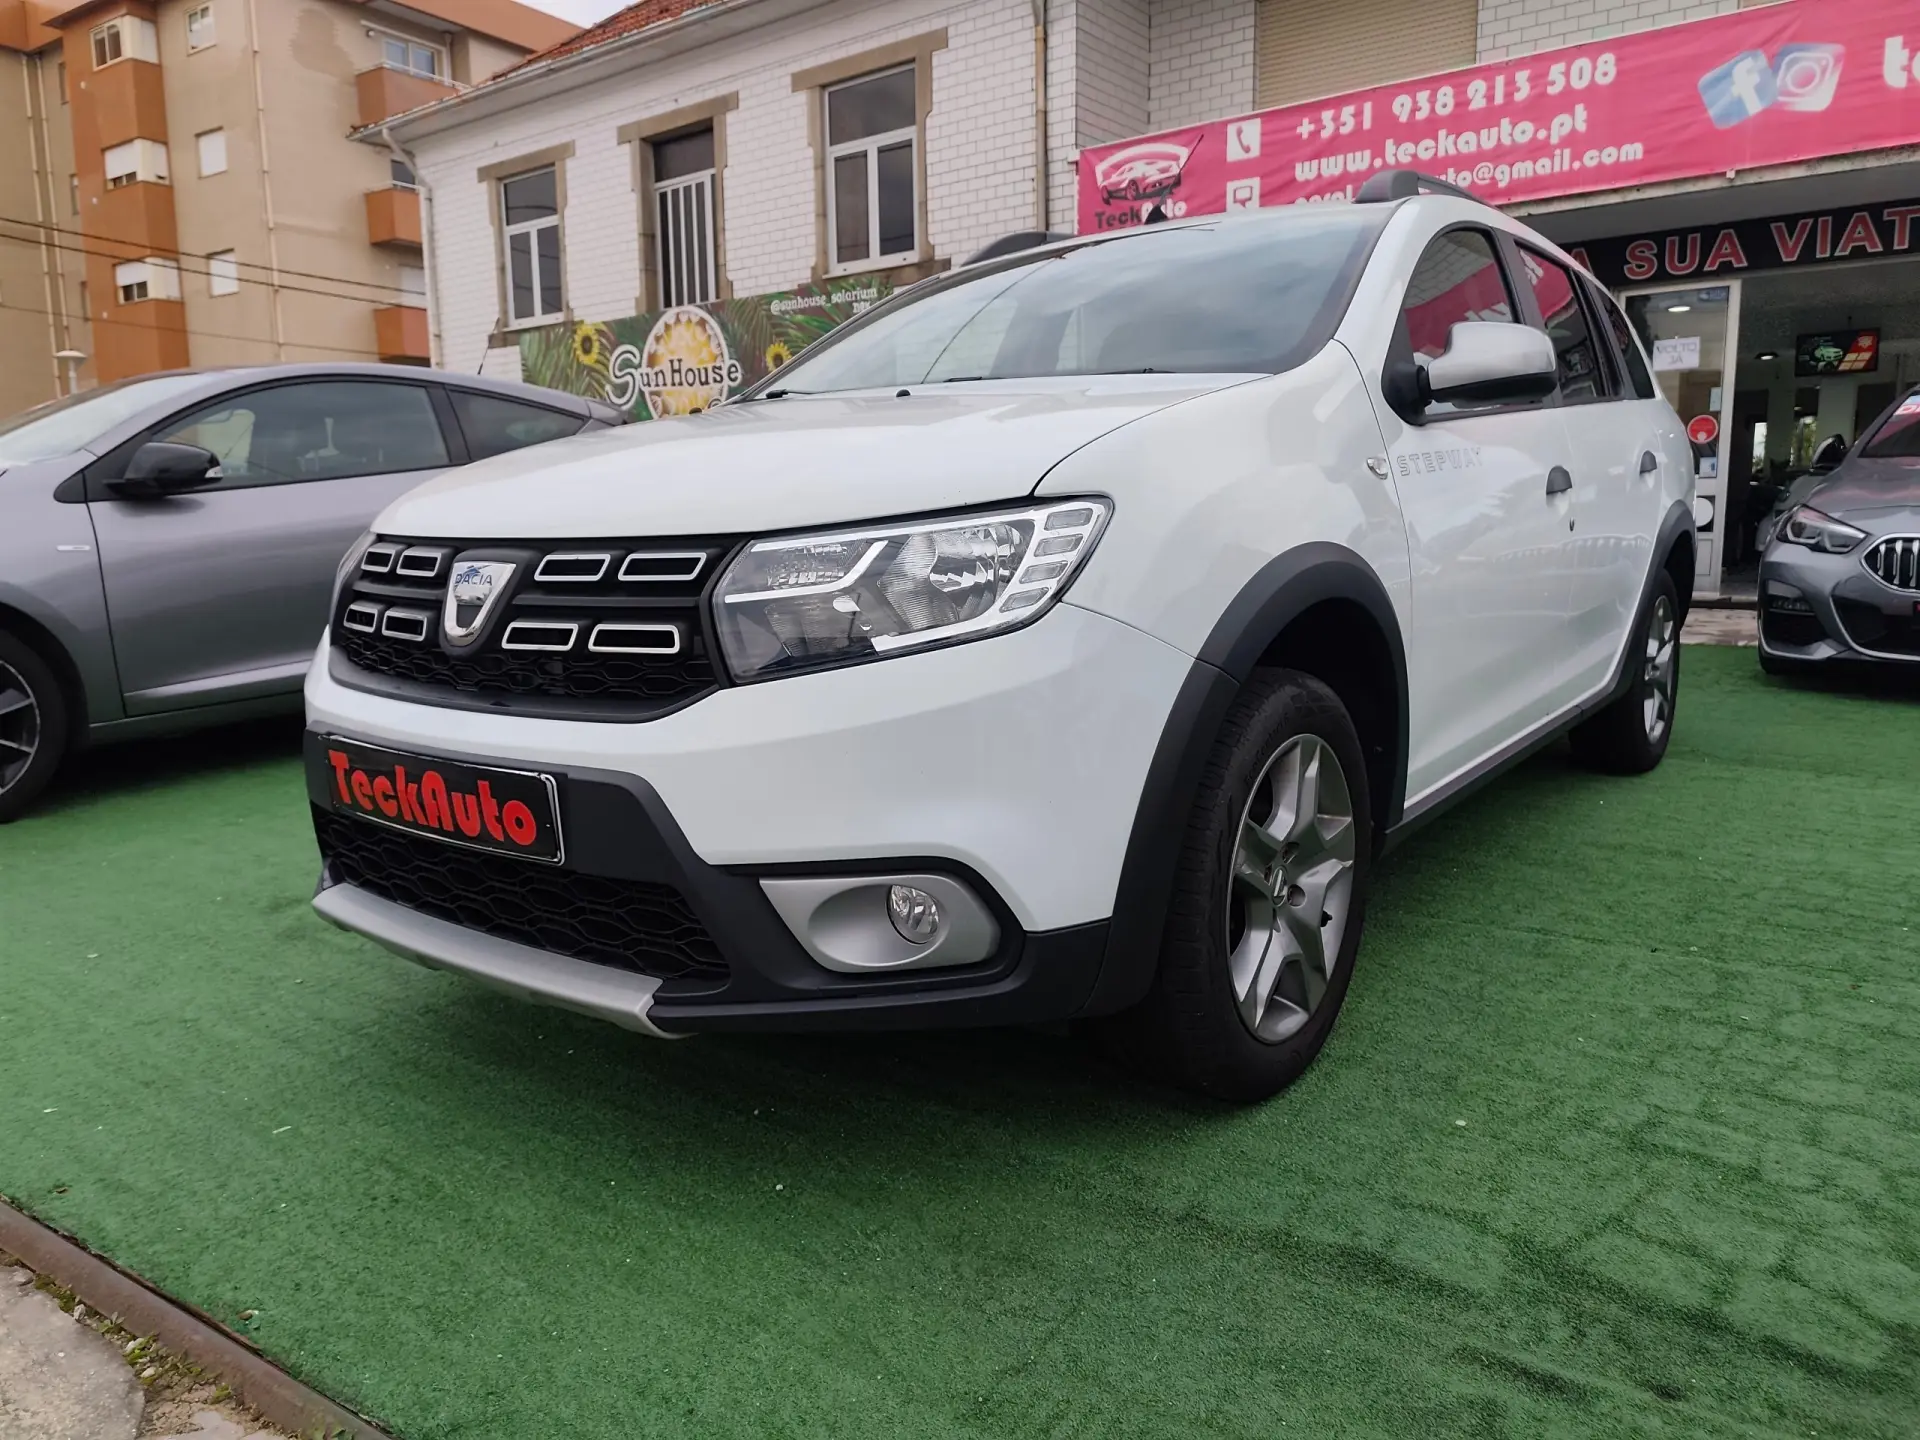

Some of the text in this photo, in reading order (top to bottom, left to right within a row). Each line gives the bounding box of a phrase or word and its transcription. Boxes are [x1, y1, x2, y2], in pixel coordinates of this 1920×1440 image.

[1296, 52, 1618, 140] +351 938 213 508
[1295, 103, 1588, 182] www.teckauto.pt
[1624, 229, 1748, 280] SUA
[605, 345, 740, 410] SunHouse
[1396, 446, 1483, 477] STEPWAY
[455, 573, 493, 586] DACIA
[328, 749, 537, 846] TeckAuto
